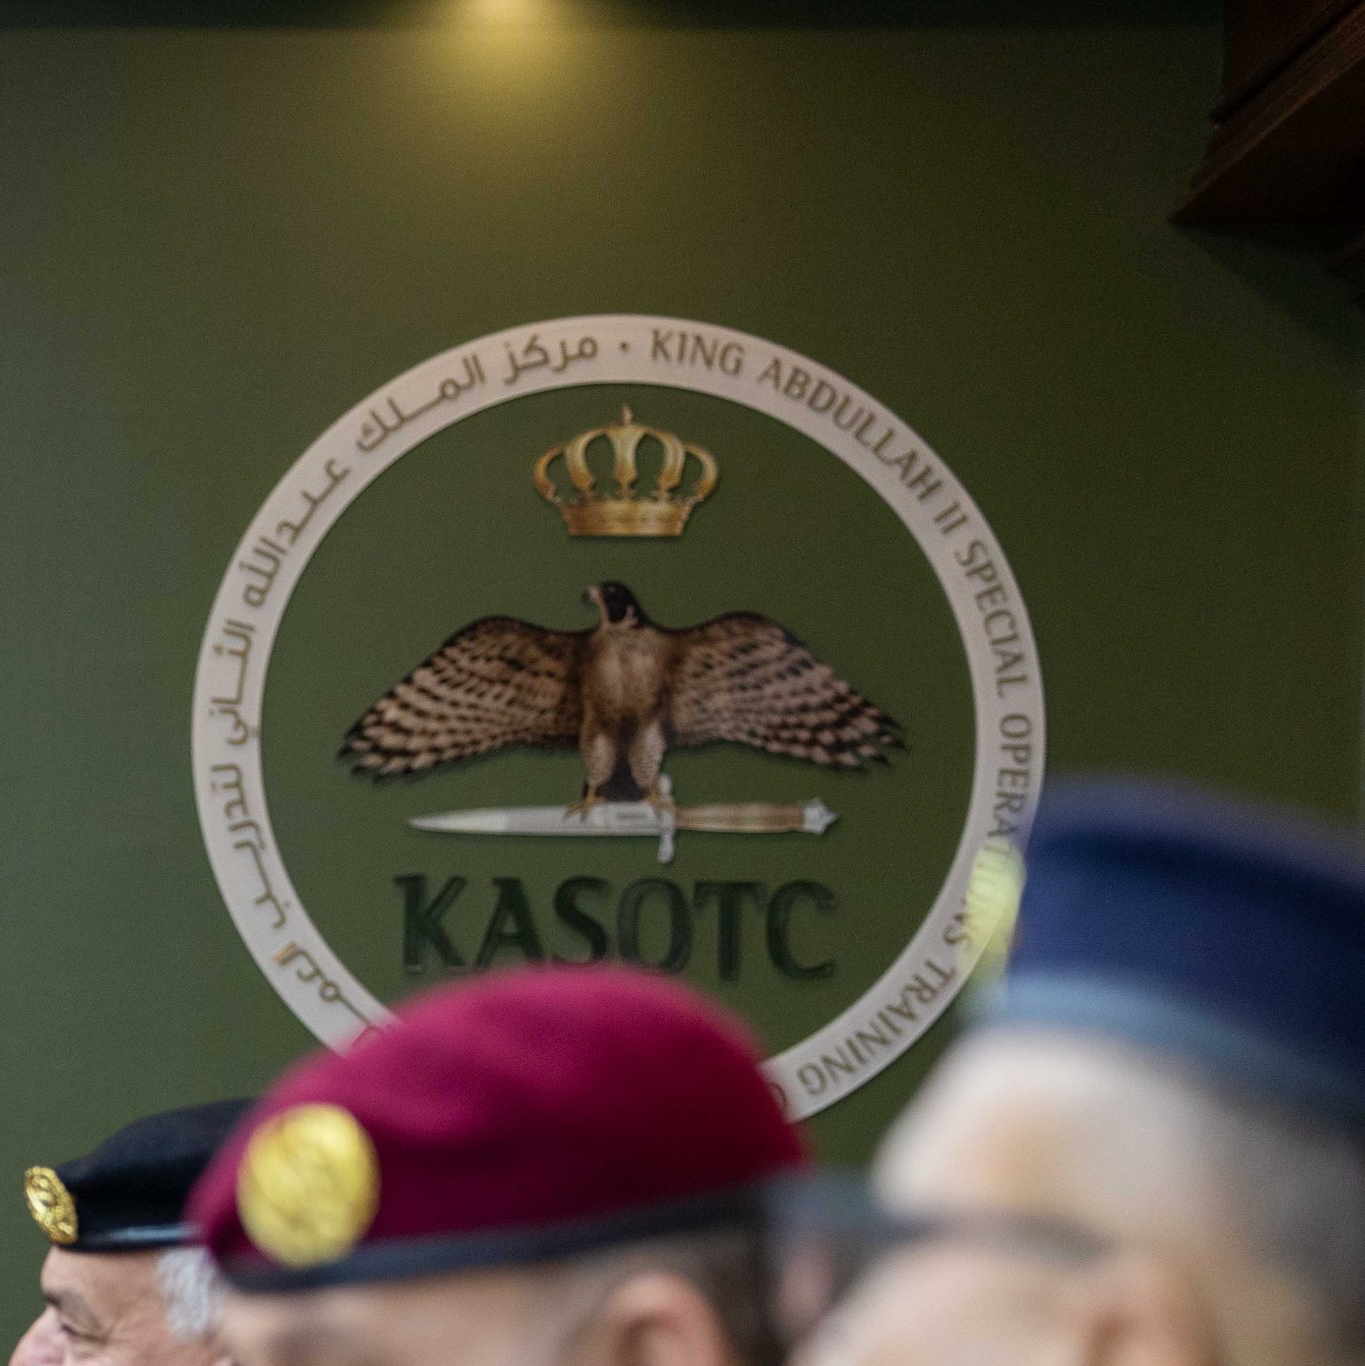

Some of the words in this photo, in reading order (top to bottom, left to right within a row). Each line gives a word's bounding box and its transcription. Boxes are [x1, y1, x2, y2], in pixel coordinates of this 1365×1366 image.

[355, 353, 486, 452] الملك
[504, 333, 598, 386] مركز
[650, 328, 745, 376] KING
[756, 356, 943, 501] ABDULLAH
[933, 501, 968, 536] II
[954, 539, 1029, 699] SPECIAL
[209, 618, 259, 747] الثاني
[392, 873, 837, 984] KASOTC
[796, 958, 957, 1096] TRAINING
